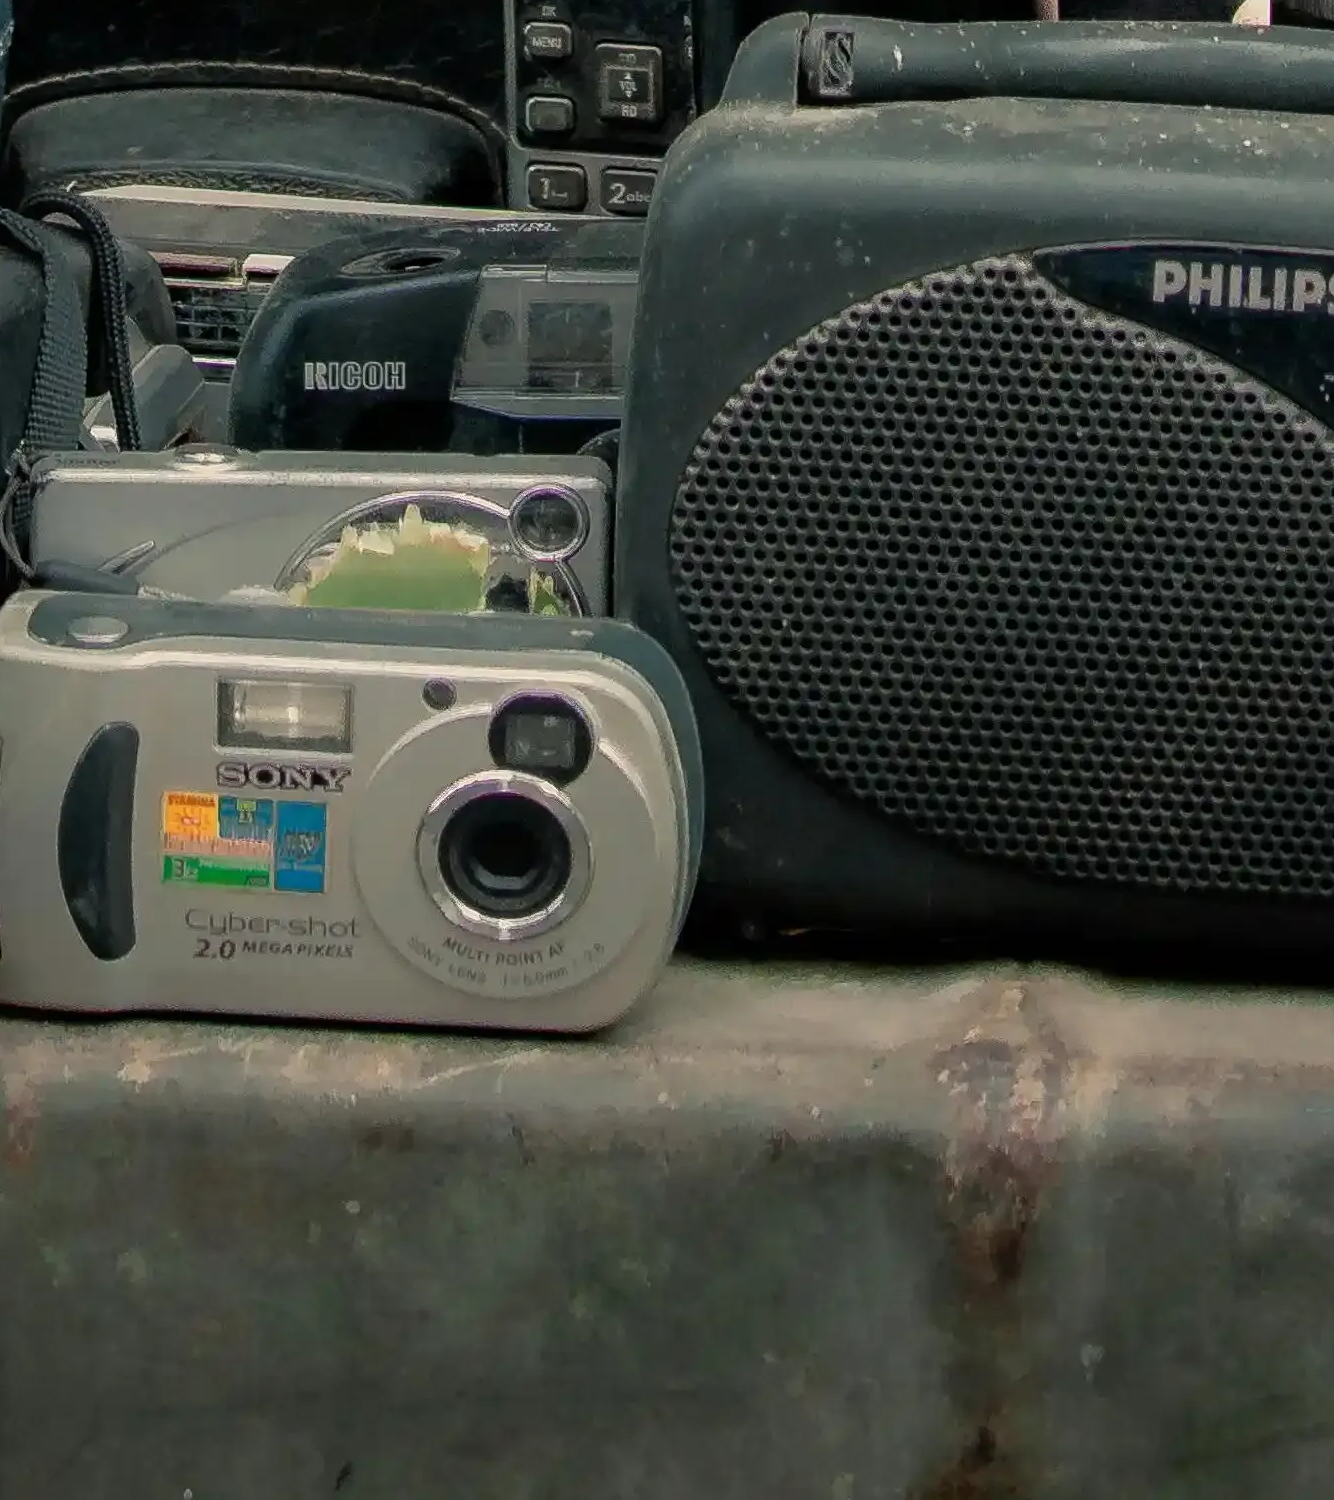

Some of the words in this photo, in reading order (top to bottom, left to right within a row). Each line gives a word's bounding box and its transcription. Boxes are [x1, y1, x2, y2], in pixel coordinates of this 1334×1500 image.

[531, 35, 563, 49] MENU
[302, 359, 407, 392] RICOH
[217, 761, 352, 793] SONY
[184, 908, 362, 943] Cyber-shot
[193, 938, 236, 961] 2.0
[442, 936, 487, 966] MULTI
[494, 949, 543, 967] POINT
